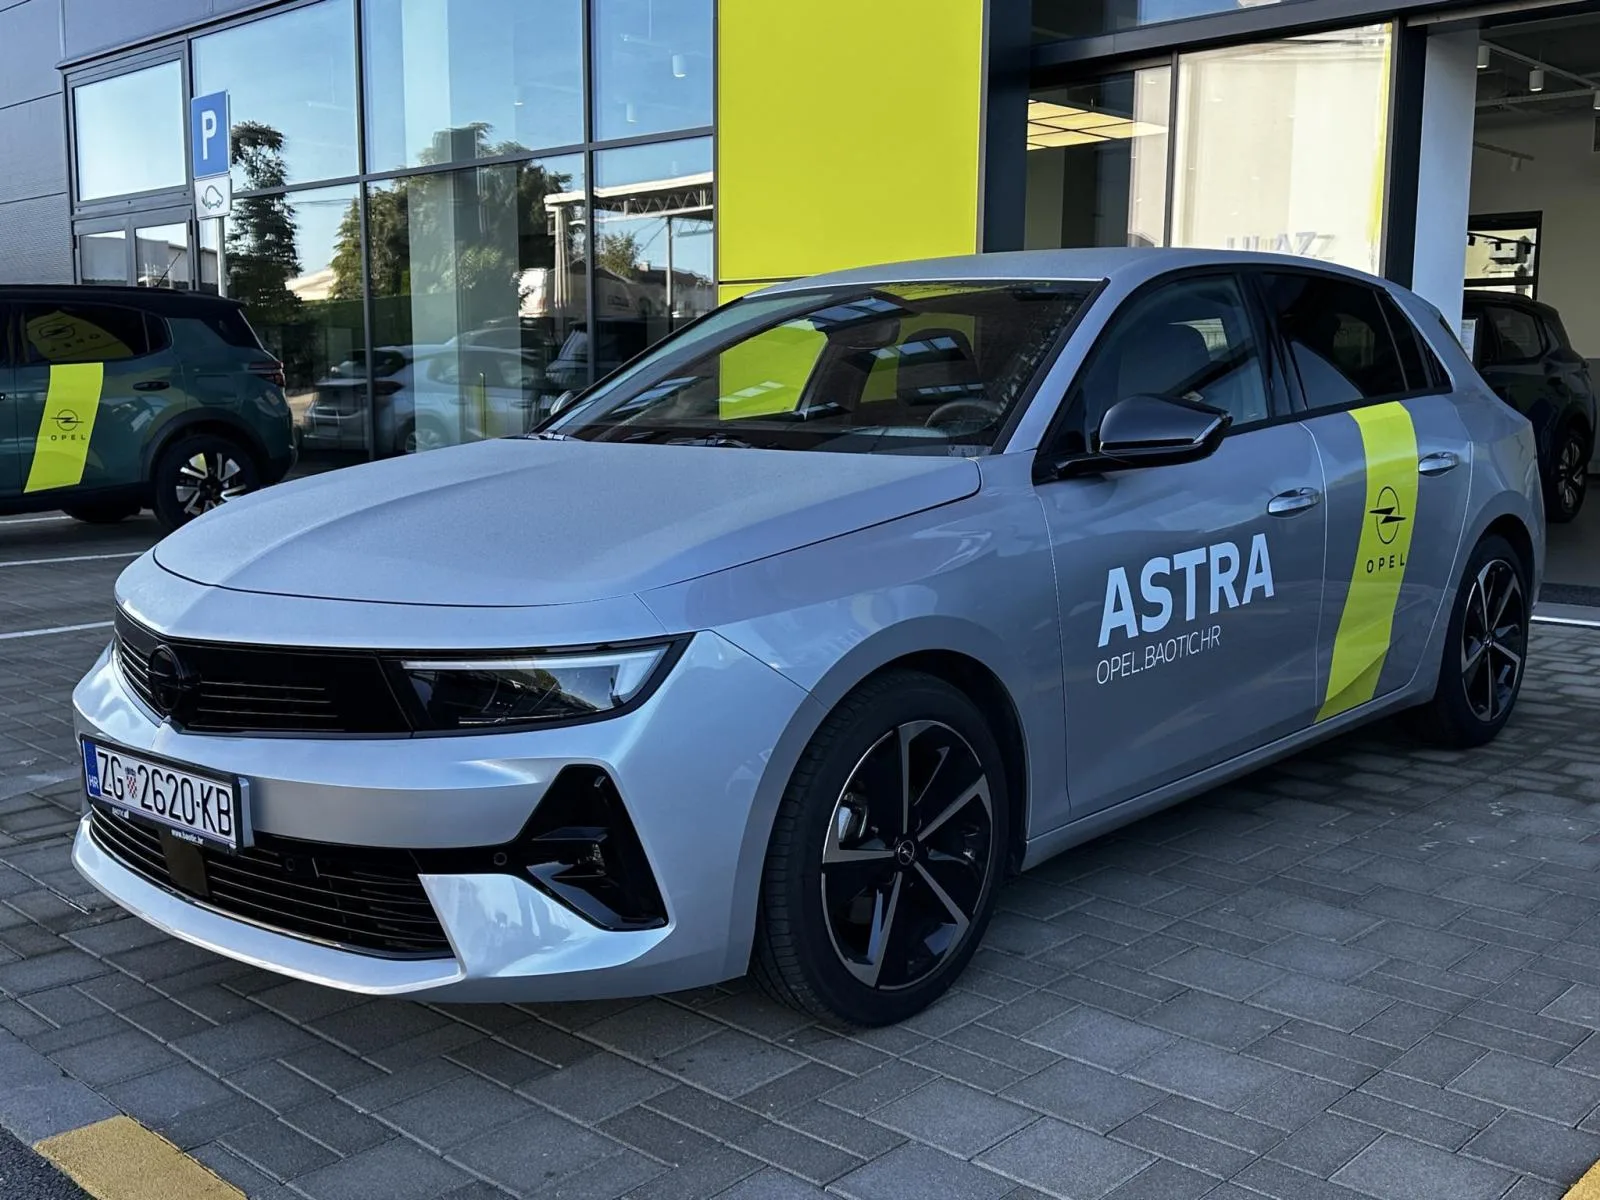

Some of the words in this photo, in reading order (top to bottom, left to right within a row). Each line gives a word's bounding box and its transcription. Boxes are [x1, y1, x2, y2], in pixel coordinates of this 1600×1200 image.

[201, 109, 217, 161] P
[1366, 553, 1405, 574] OPEL
[1097, 533, 1275, 648] ASTRA
[88, 774, 100, 789] HR
[97, 751, 124, 801] ZG
